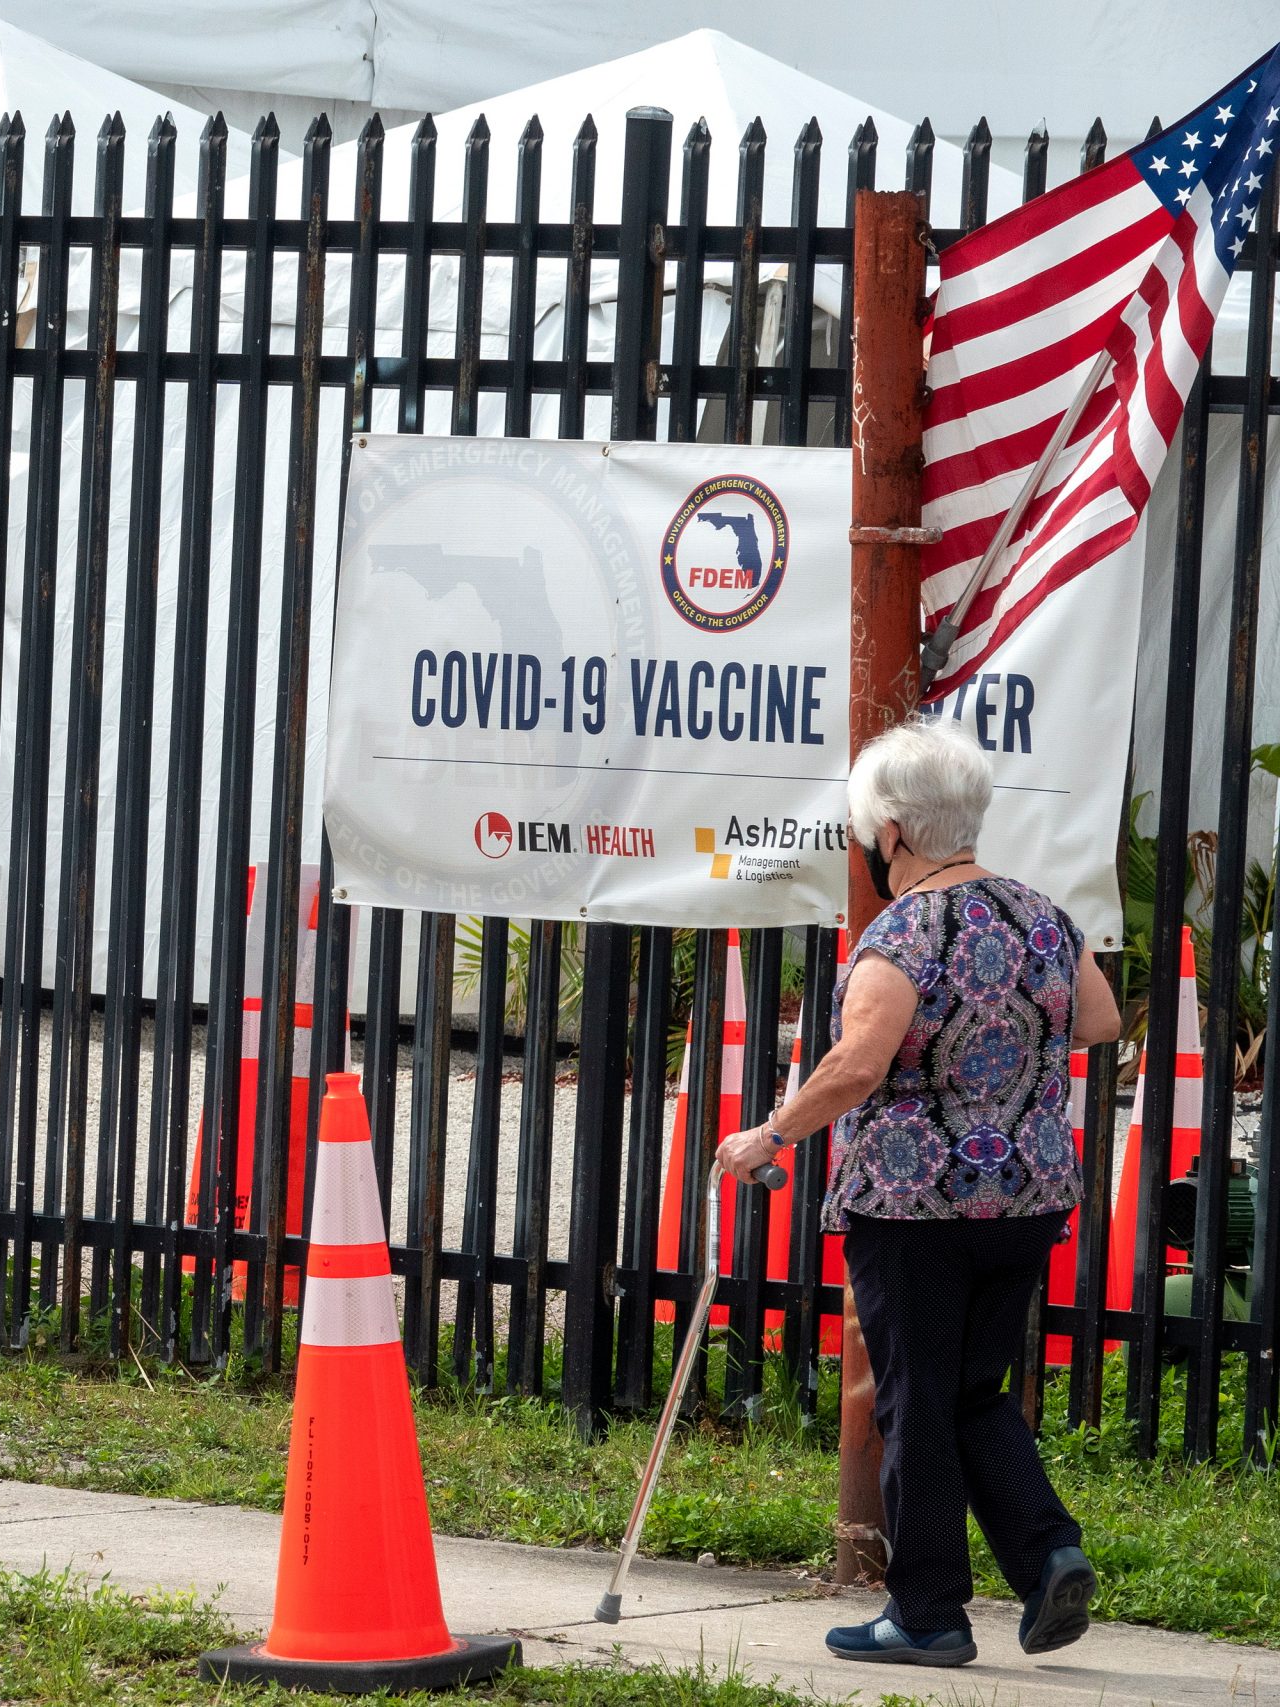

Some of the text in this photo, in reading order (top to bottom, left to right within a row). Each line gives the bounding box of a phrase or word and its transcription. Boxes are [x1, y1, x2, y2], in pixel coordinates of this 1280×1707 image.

[668, 479, 785, 548] DIVISION OF EMERGENCY MANAGEMENT
[391, 442, 551, 489] EMERGENCY
[550, 464, 647, 658] MANAGEMENT
[688, 567, 754, 590] FDEM
[672, 590, 769, 627] OFFICE OF THE GOVERNOR
[411, 649, 608, 736] COVID-19
[630, 657, 827, 746] VACCINE
[586, 824, 657, 859] HEALTH
[724, 815, 848, 852] AshBritt
[326, 808, 613, 908] FFICE OF THE GOVERNR
[738, 855, 801, 870] Management
[735, 870, 794, 884] & Logistics
